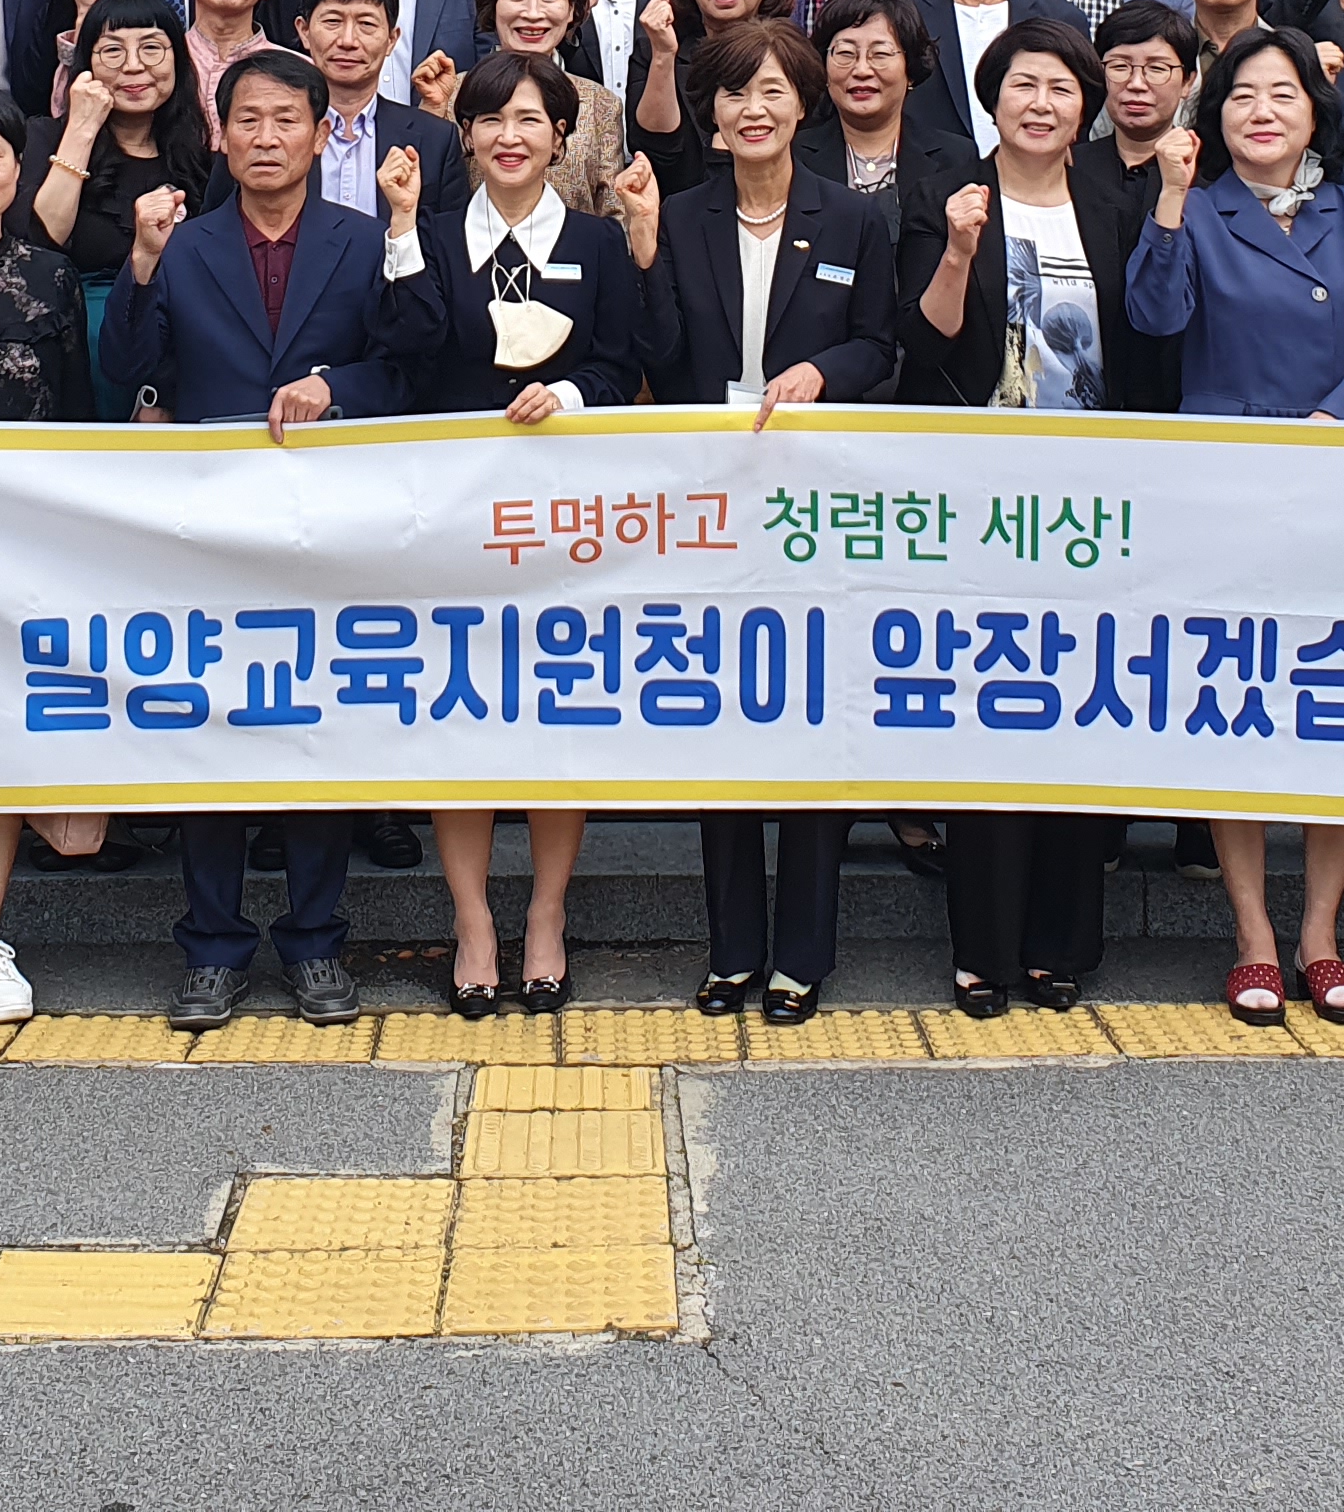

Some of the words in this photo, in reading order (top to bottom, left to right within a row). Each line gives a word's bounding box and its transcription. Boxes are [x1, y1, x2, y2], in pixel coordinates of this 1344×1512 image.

[483, 492, 738, 566] 투명하고
[762, 487, 957, 563] 청렴한
[979, 494, 1131, 569] 세상!
[20, 603, 825, 732] 밀양교육지원청이
